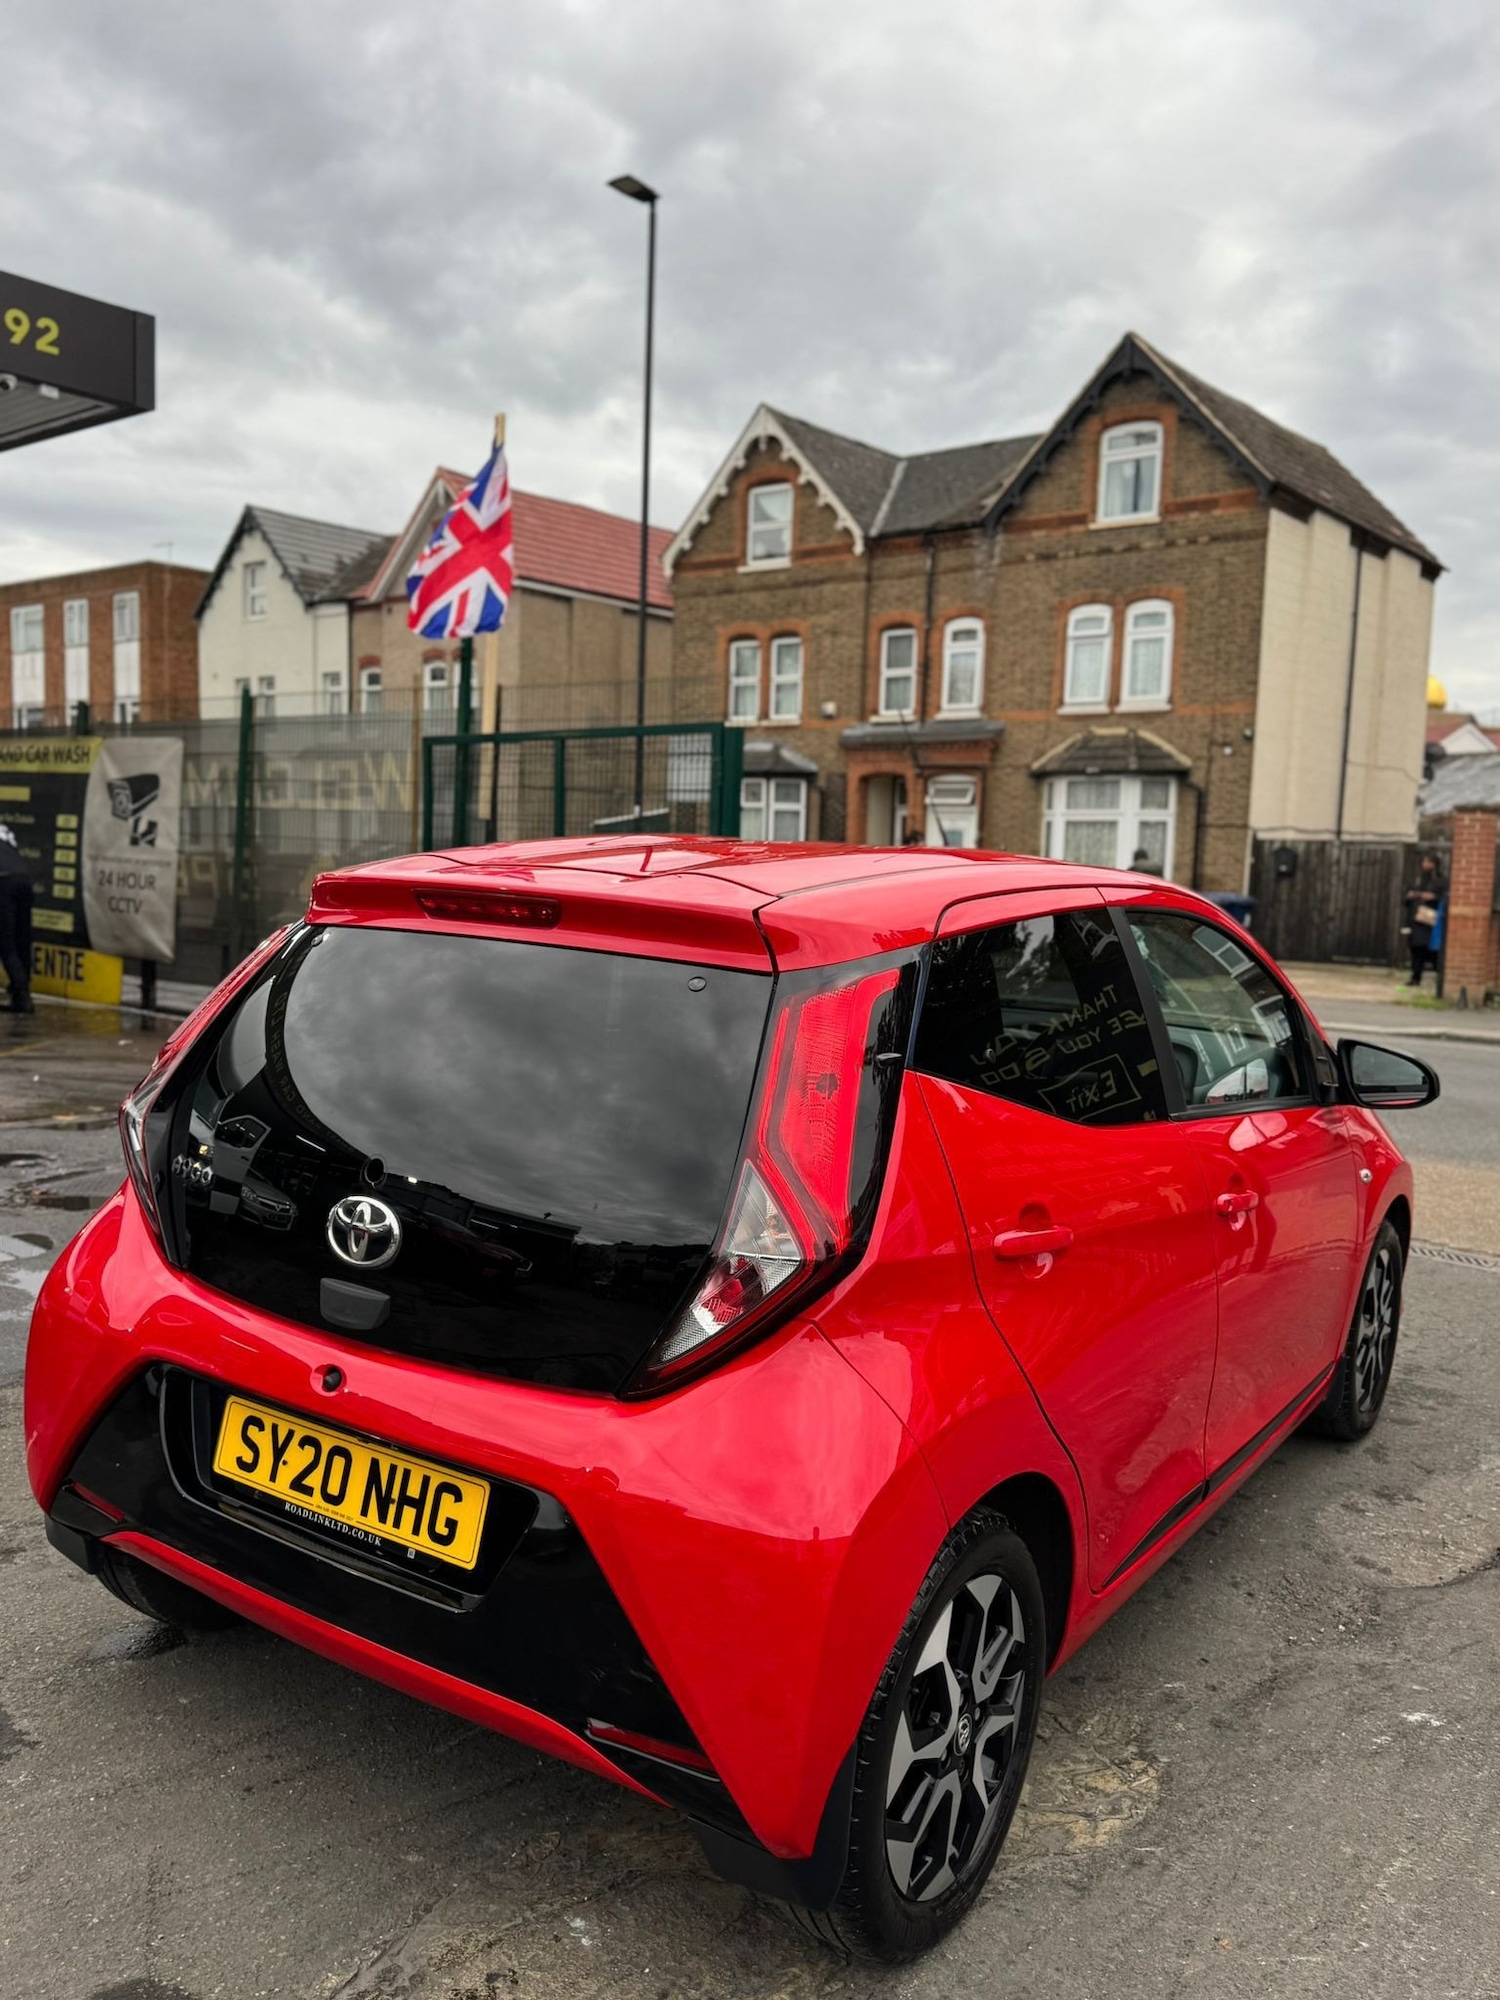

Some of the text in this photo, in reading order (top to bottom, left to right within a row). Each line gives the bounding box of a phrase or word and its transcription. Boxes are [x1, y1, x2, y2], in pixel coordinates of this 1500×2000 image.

[4, 307, 61, 356] 92
[25, 745, 50, 763] CAR
[53, 744, 91, 763] WASH
[98, 870, 157, 891] 24 HOUR
[107, 896, 143, 915] CCTV
[171, 1154, 214, 1187] AYGO
[235, 1414, 463, 1547] SY20 NHG
[284, 1502, 382, 1547] ROADLINKLTD.CO.UK
